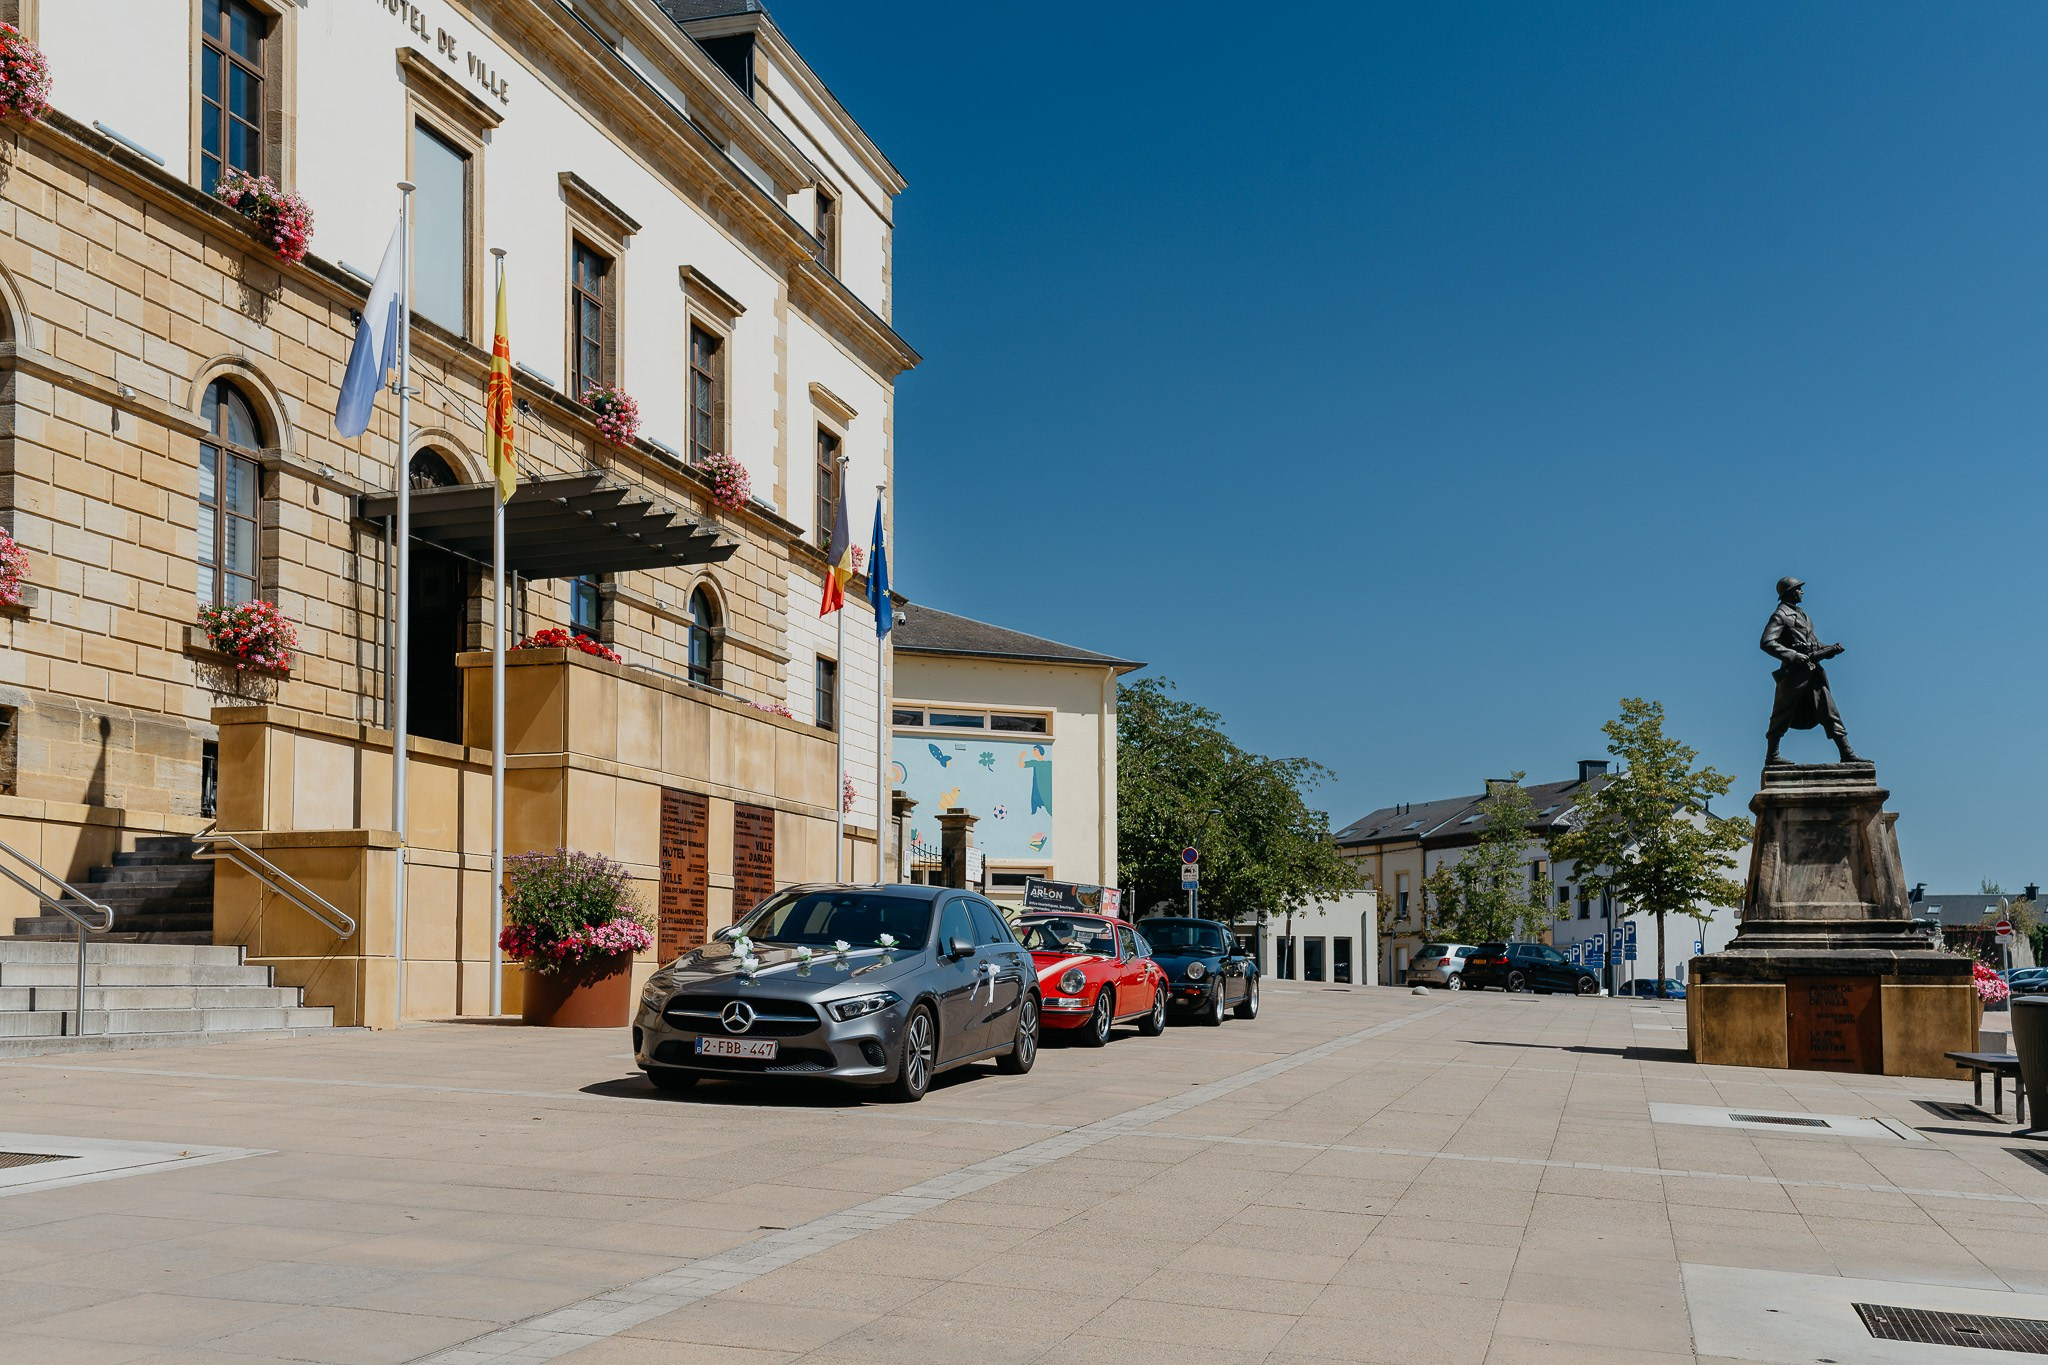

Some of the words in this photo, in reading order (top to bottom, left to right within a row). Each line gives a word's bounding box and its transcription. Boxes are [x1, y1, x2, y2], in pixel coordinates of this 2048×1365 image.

[377, 0, 431, 42] TEL
[438, 27, 458, 62] DE
[467, 51, 509, 104] VILLE
[755, 841, 772, 852] VILLE
[662, 860, 672, 870] DE
[662, 872, 682, 885] VILLE
[1030, 888, 1063, 900] ARLON
[1613, 932, 1622, 946] P
[1626, 925, 1634, 940] P
[1585, 942, 1592, 955] P
[1595, 937, 1602, 951] P
[1695, 942, 1702, 953] P
[1573, 948, 1579, 960] P
[703, 1040, 774, 1056] 2-FBB-447
